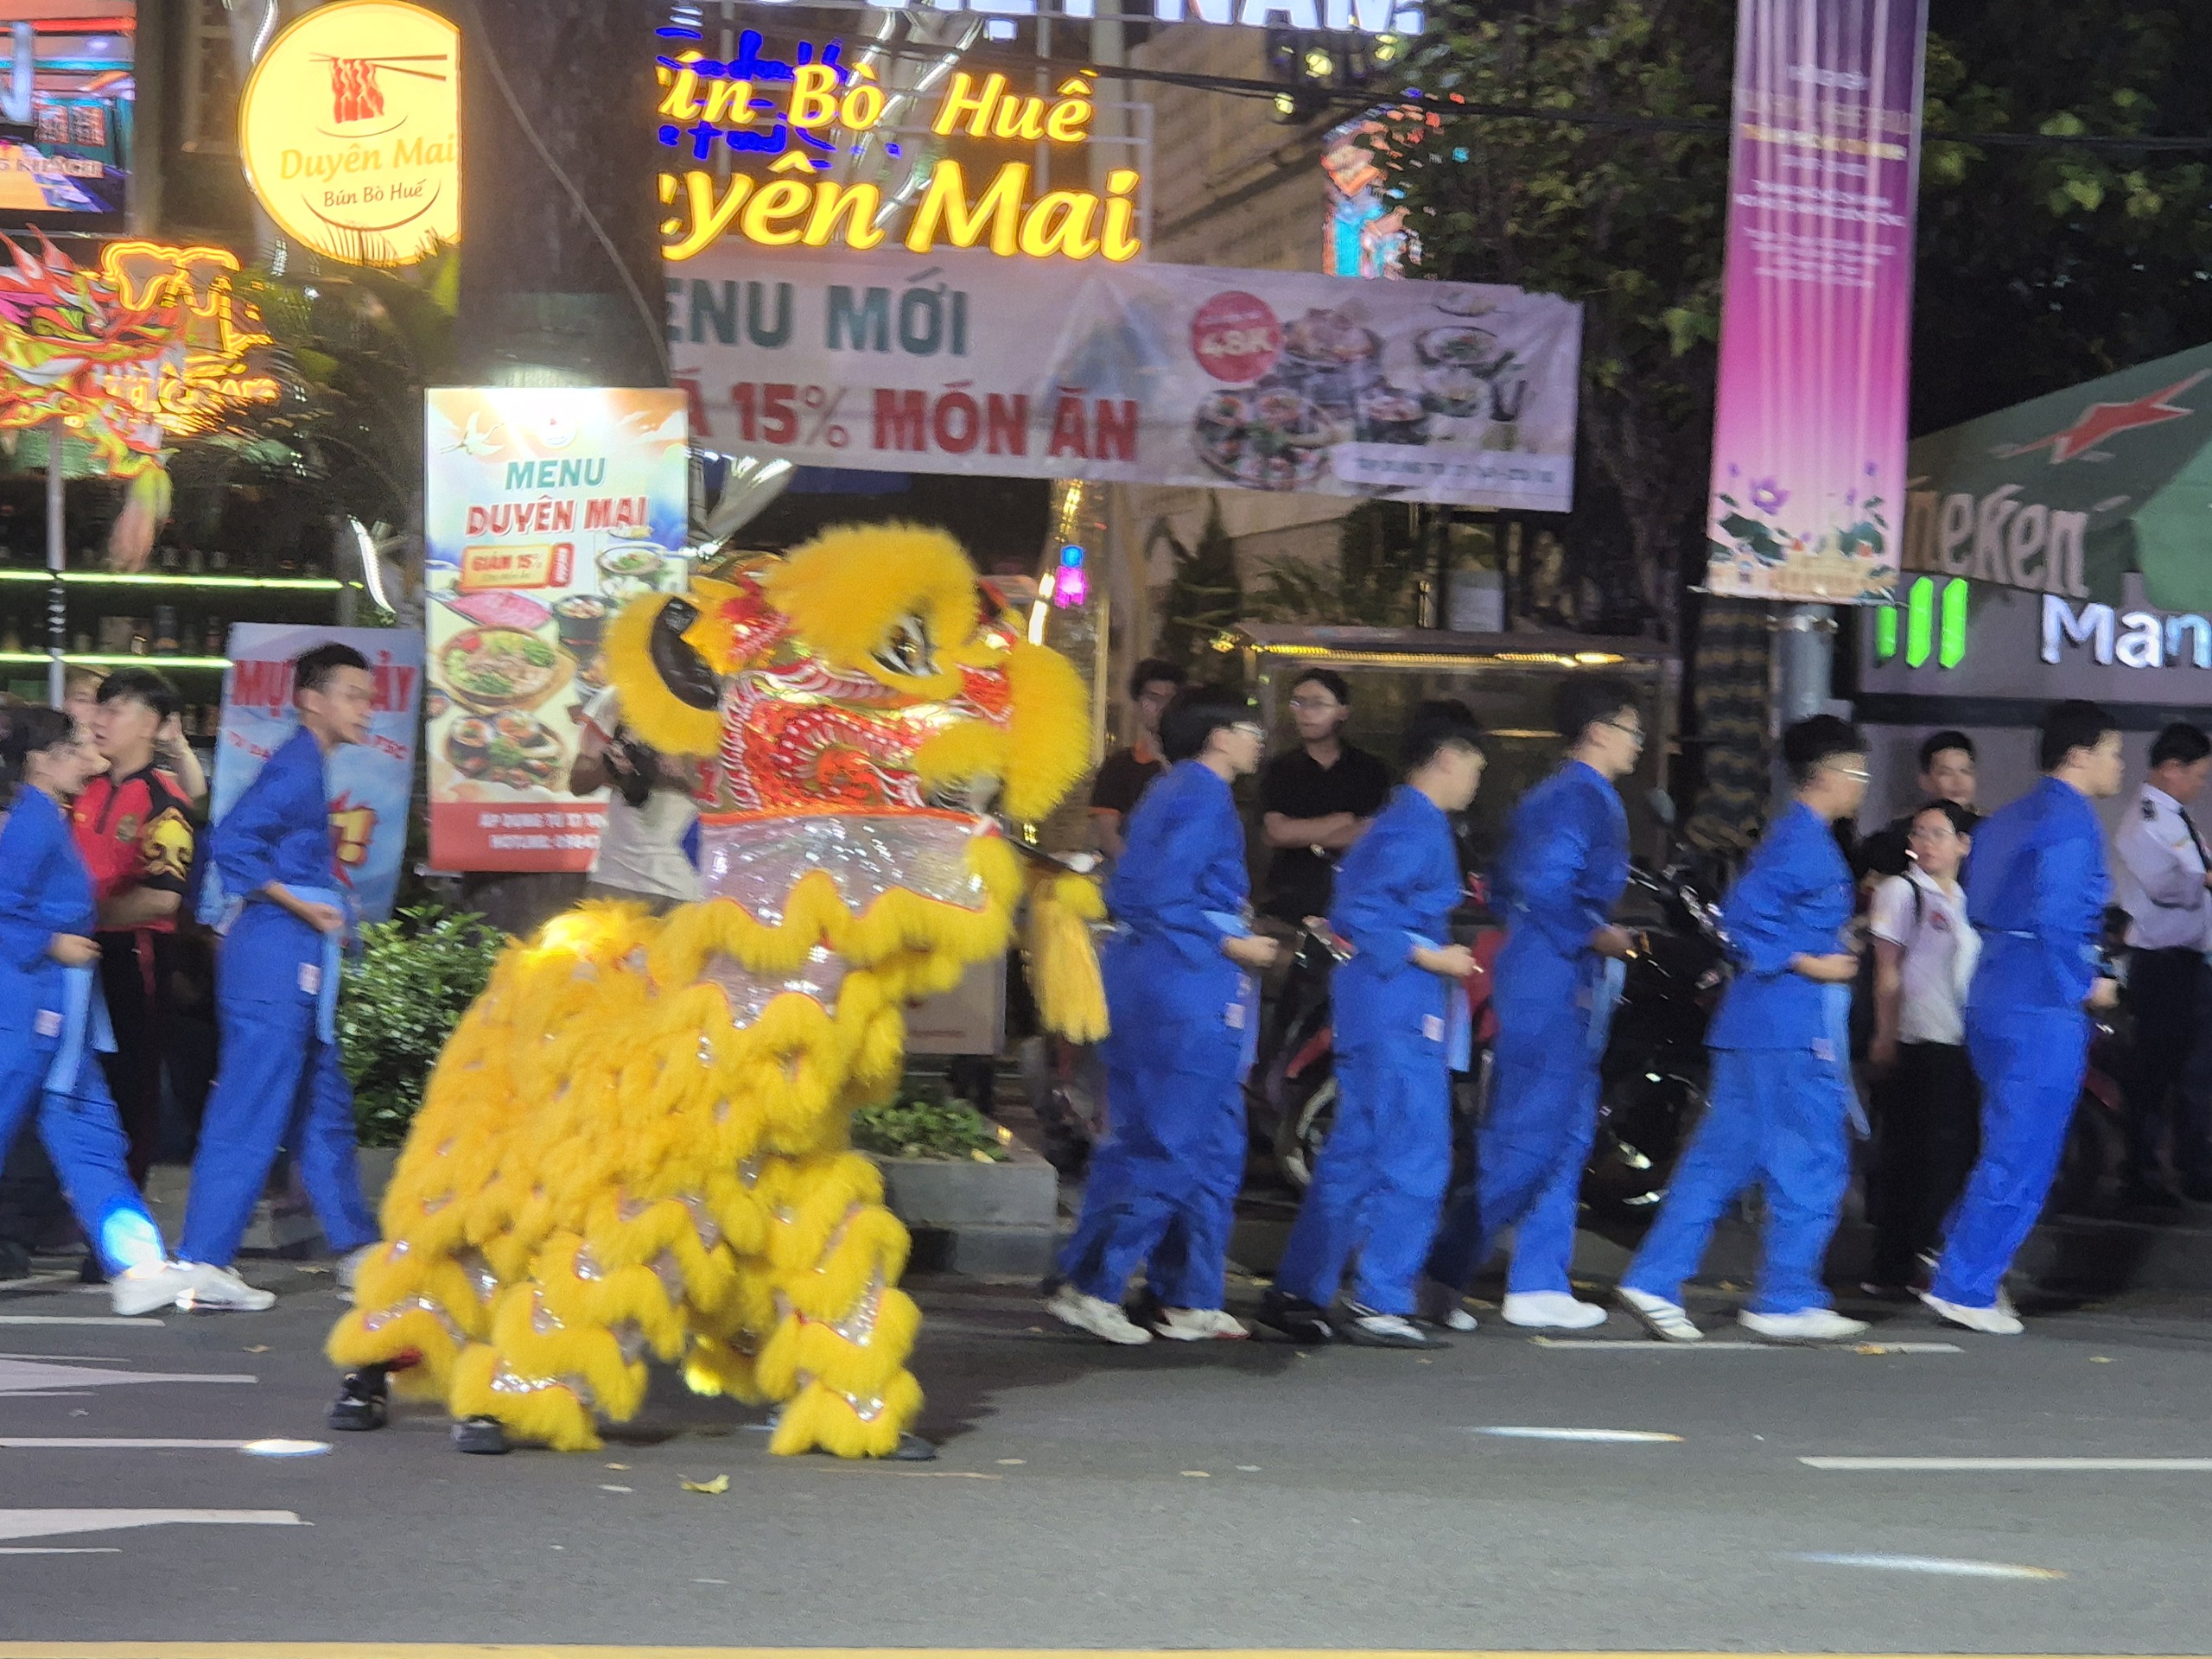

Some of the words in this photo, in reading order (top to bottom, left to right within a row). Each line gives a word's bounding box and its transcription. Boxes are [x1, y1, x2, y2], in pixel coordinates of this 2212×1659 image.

[787, 61, 886, 131] Bò
[280, 143, 382, 183] Duyên
[392, 132, 457, 169] Mai
[324, 189, 359, 207] Bún
[363, 185, 385, 204] Bò
[390, 178, 427, 201] Huế
[906, 160, 1142, 262] Mai
[827, 265, 969, 357] MỚI
[731, 381, 849, 448] 15%
[873, 379, 1029, 456] MÓN
[1047, 385, 1141, 462] ĂN
[505, 458, 606, 491] MENU
[465, 494, 575, 536] DUYÊN
[583, 496, 648, 531] MAI
[2042, 594, 2212, 671] Man
